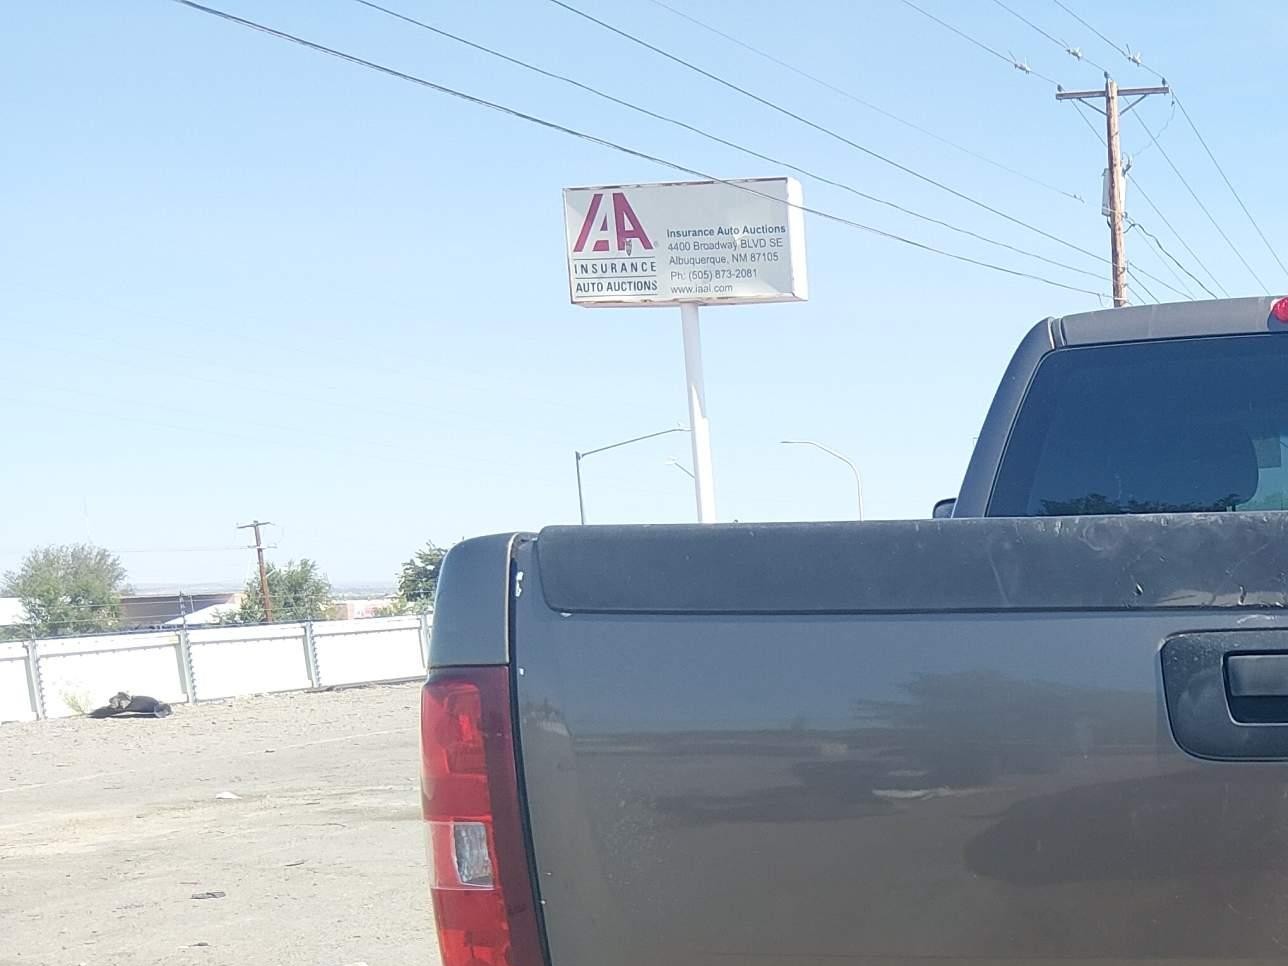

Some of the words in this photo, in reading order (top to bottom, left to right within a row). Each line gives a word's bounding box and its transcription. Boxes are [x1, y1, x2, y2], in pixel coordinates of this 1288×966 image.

[667, 228, 715, 238] Insurance
[717, 226, 739, 236] Auto
[742, 224, 786, 234] Auctions
[668, 242, 691, 252] 4400
[693, 240, 737, 251] Broadway
[740, 239, 766, 249] BLVD
[769, 238, 784, 247] SE
[669, 255, 730, 266] Albuquerque,
[731, 253, 748, 263] NM
[750, 252, 779, 262] 87105
[574, 261, 657, 275] INSURANCE
[670, 271, 686, 280] Ph:
[688, 270, 713, 281] (505)
[715, 268, 757, 279] 873-2081
[576, 281, 603, 293] AUTO
[606, 280, 658, 292] AUCTIONS
